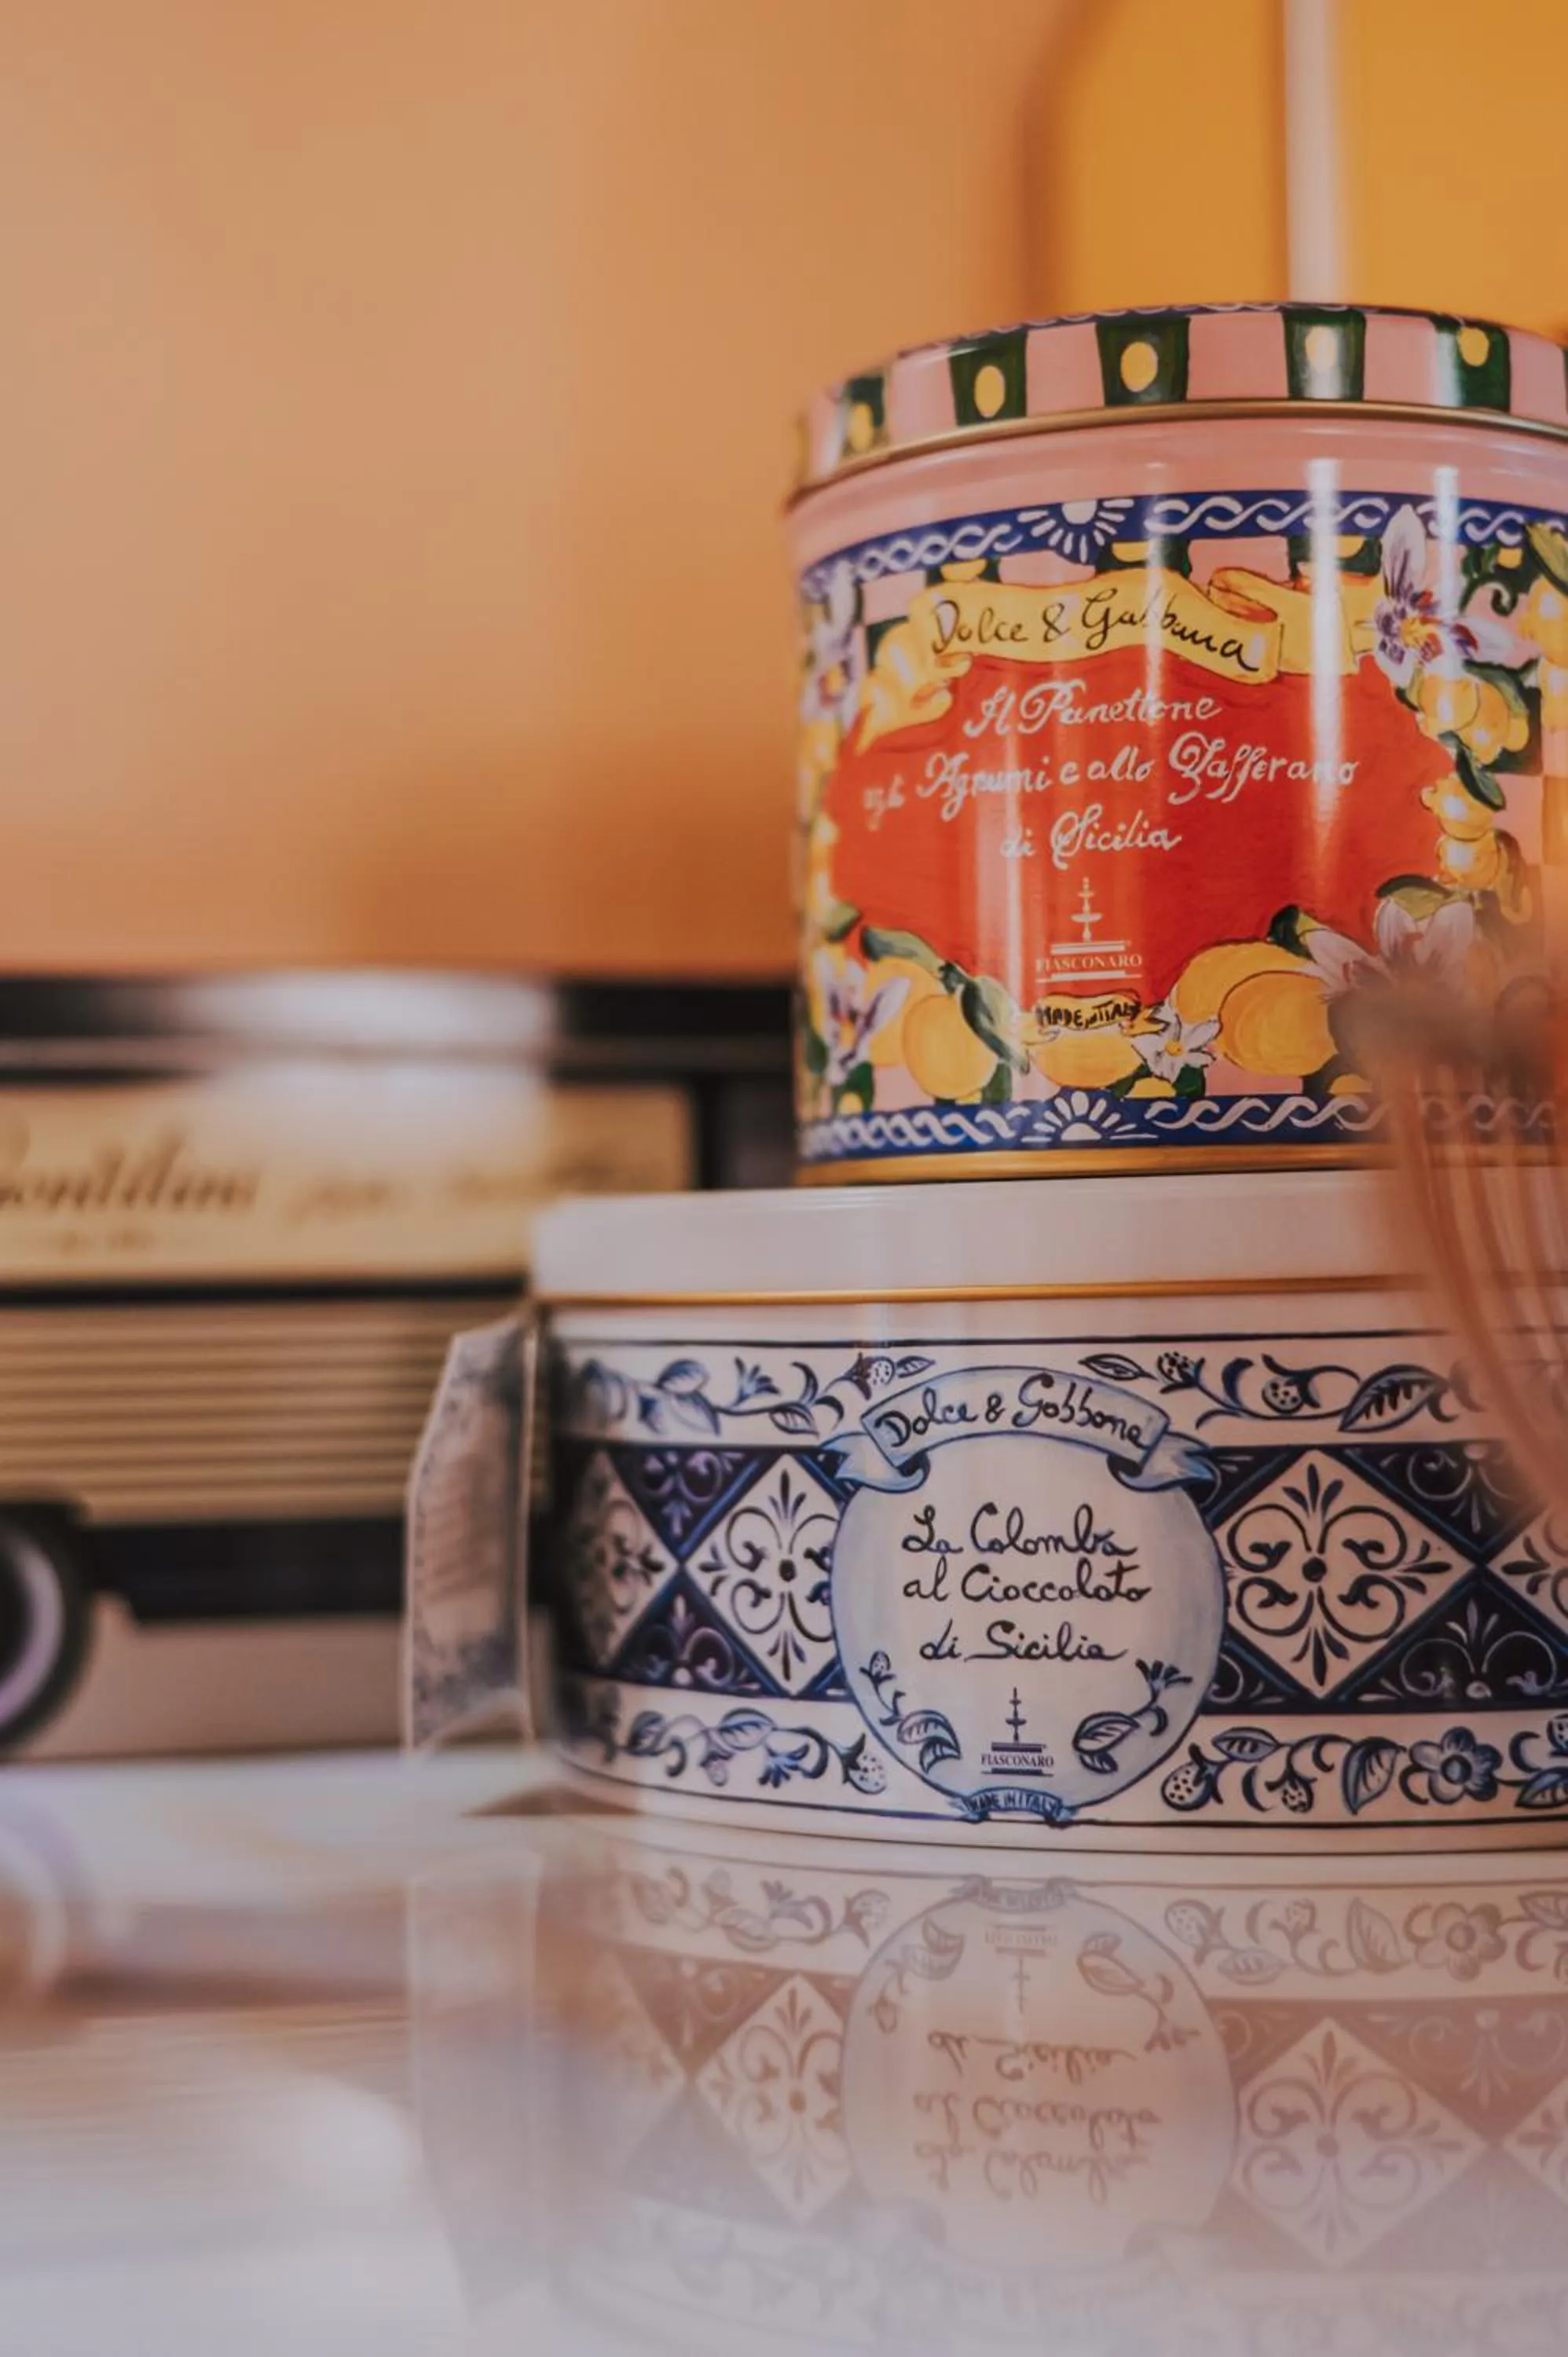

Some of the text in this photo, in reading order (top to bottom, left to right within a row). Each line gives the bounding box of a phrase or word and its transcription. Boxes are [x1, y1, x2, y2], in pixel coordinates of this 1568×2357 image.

[930, 587, 1260, 673] Dolce & Gabbana
[962, 678, 1222, 739] Il Panettone
[915, 751, 1053, 823] Agrumi
[1167, 731, 1361, 805] Zafferano
[1000, 803, 1182, 870] di Sicilia
[1035, 954, 1143, 973] FIASCONARO
[873, 1373, 1152, 1451] Dolce & Gabbana
[901, 1501, 1138, 1556] La Colomba
[903, 1554, 1152, 1603] al Cioccolato
[918, 1618, 1130, 1662] di Sicilia
[980, 1753, 1055, 1768] FIASCONARO
